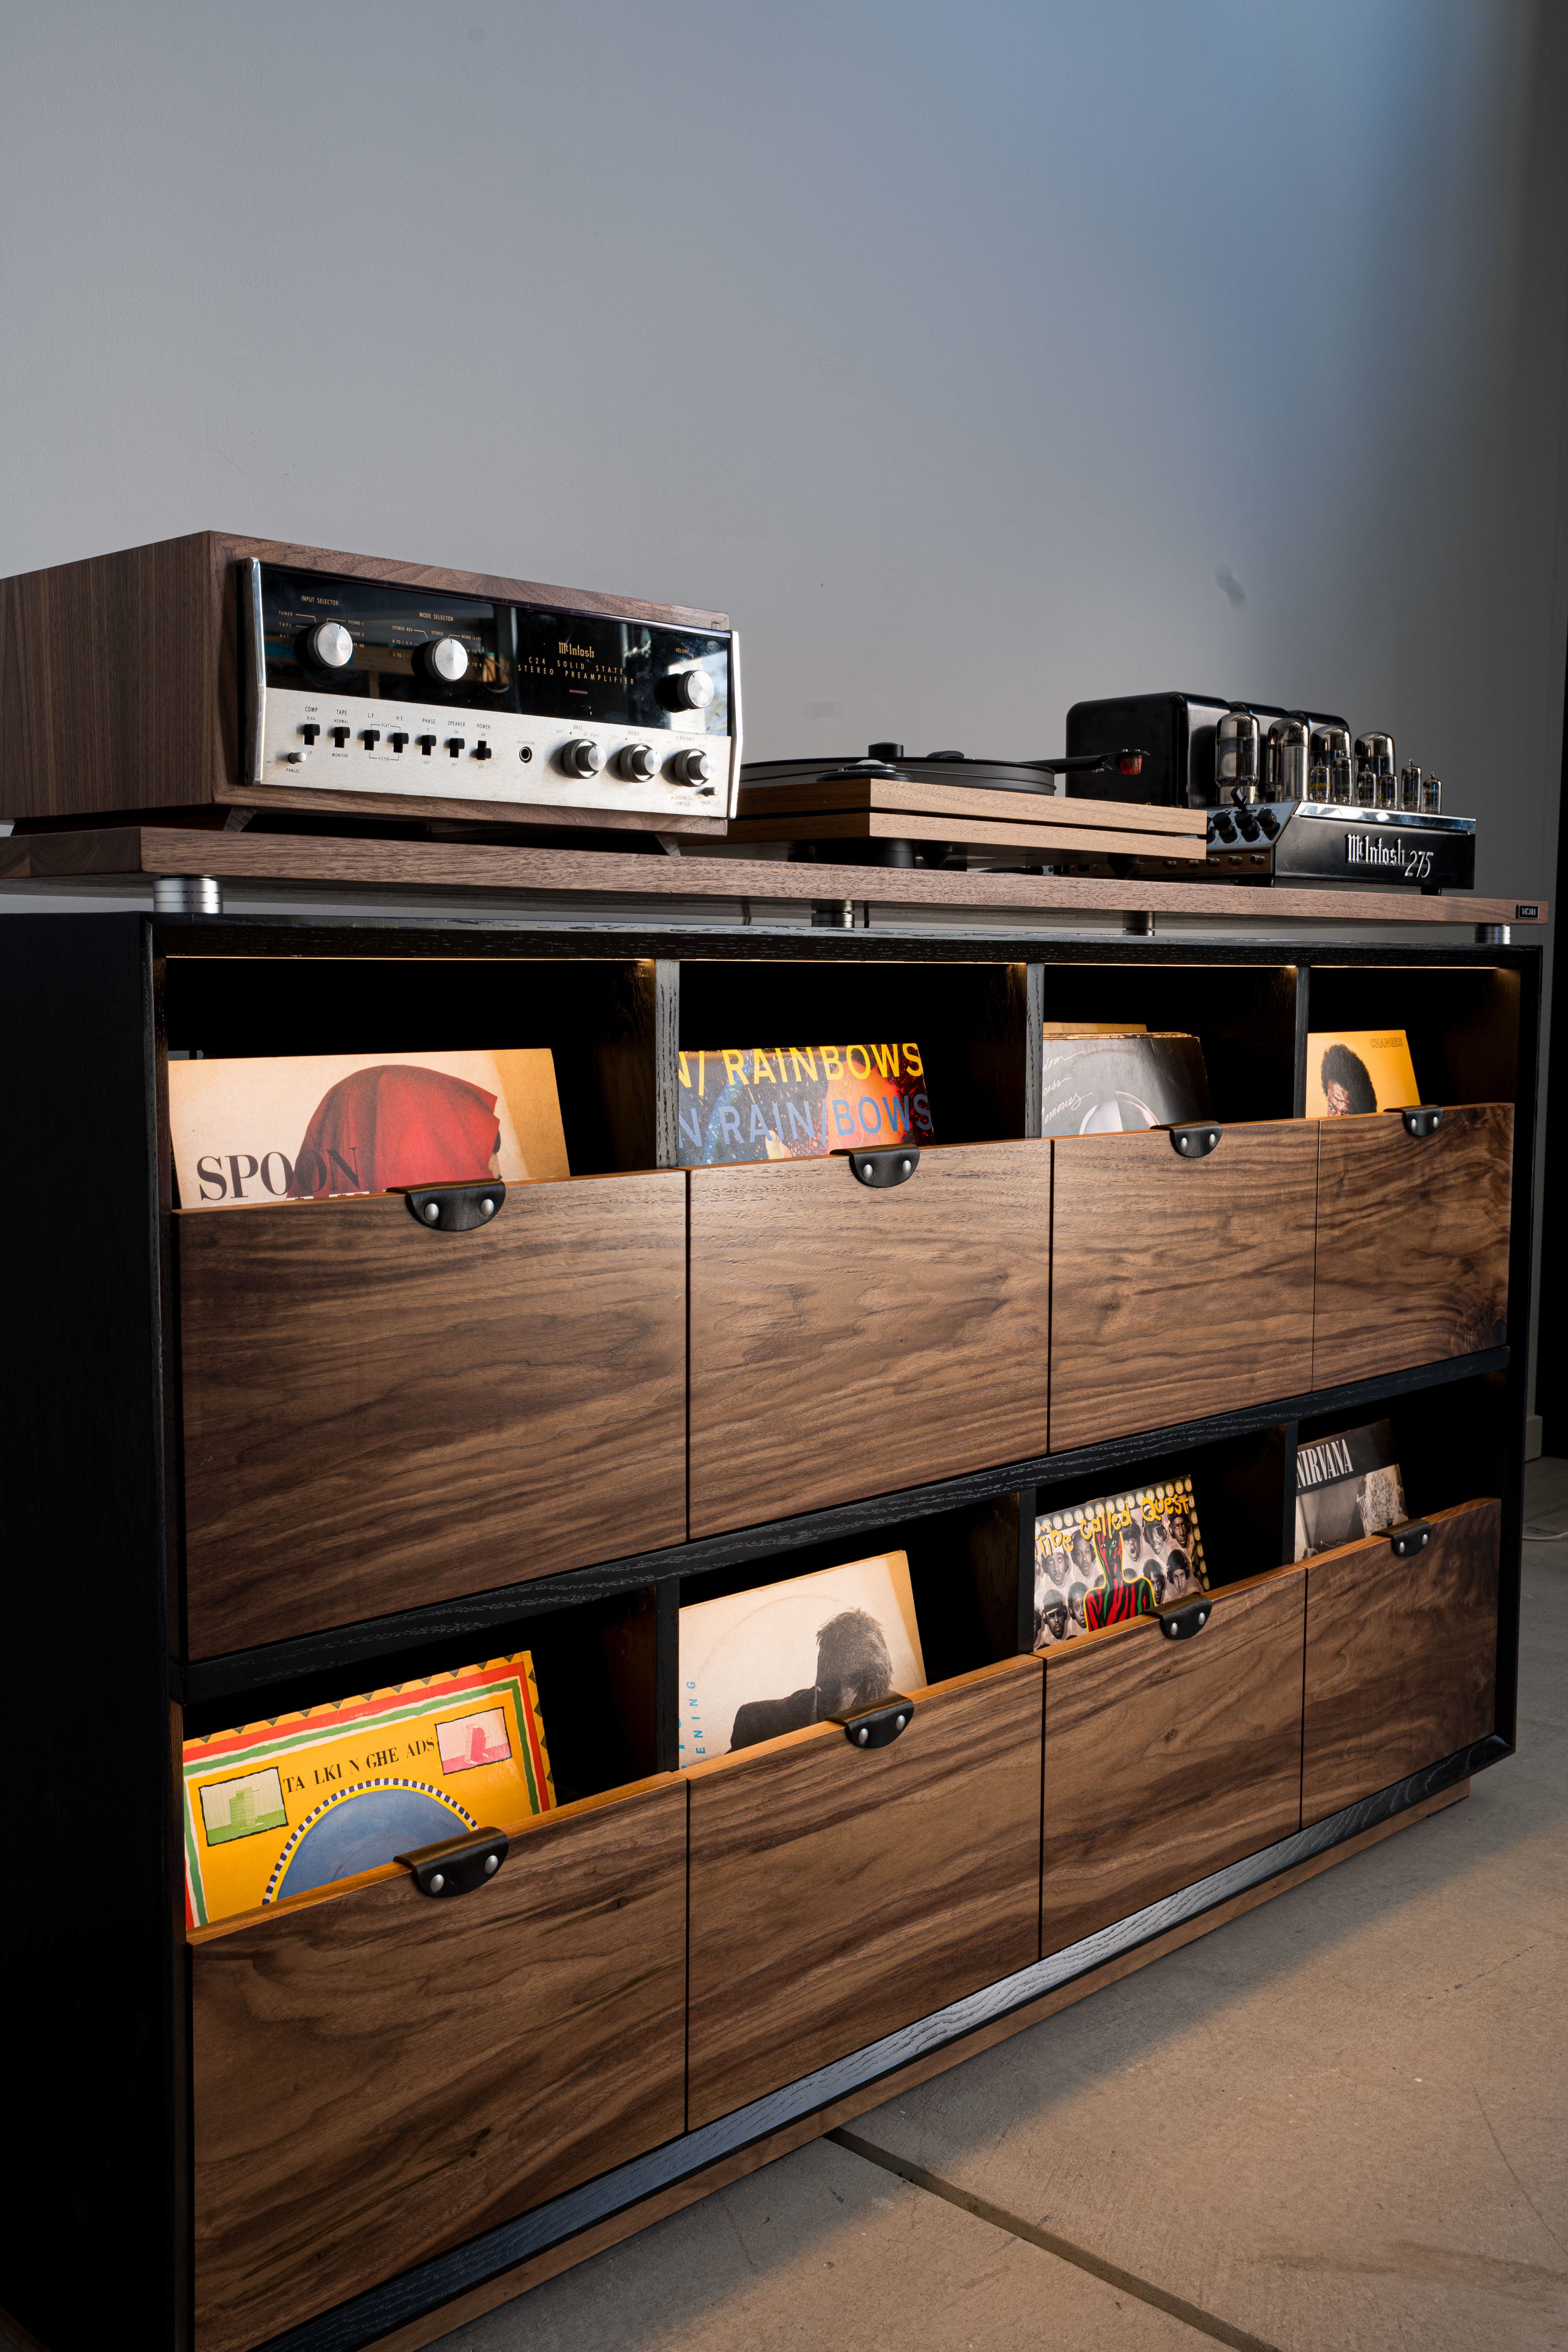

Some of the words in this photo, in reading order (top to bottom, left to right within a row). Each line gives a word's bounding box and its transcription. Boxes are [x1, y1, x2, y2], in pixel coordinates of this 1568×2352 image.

[317, 598, 339, 606] SELECTOR
[433, 614, 454, 622] SELECTOR
[559, 641, 595, 658] McIntosh
[518, 664, 554, 675] STEREO
[565, 670, 634, 685] PREAMPLIFIER
[529, 656, 545, 665] C24
[557, 660, 585, 670] SOLID
[596, 665, 623, 675] STATE
[1348, 834, 1405, 866] McIntosh
[1404, 850, 1434, 878] 275
[1370, 1037, 1404, 1049] CHANGES
[721, 1043, 923, 1086] RAINBOWS
[1042, 1077, 1071, 1096] cess
[196, 1146, 360, 1202] SPOON
[1296, 1438, 1354, 1488] NIRVANA
[1080, 1500, 1132, 1540] called
[1140, 1494, 1190, 1522] Quest
